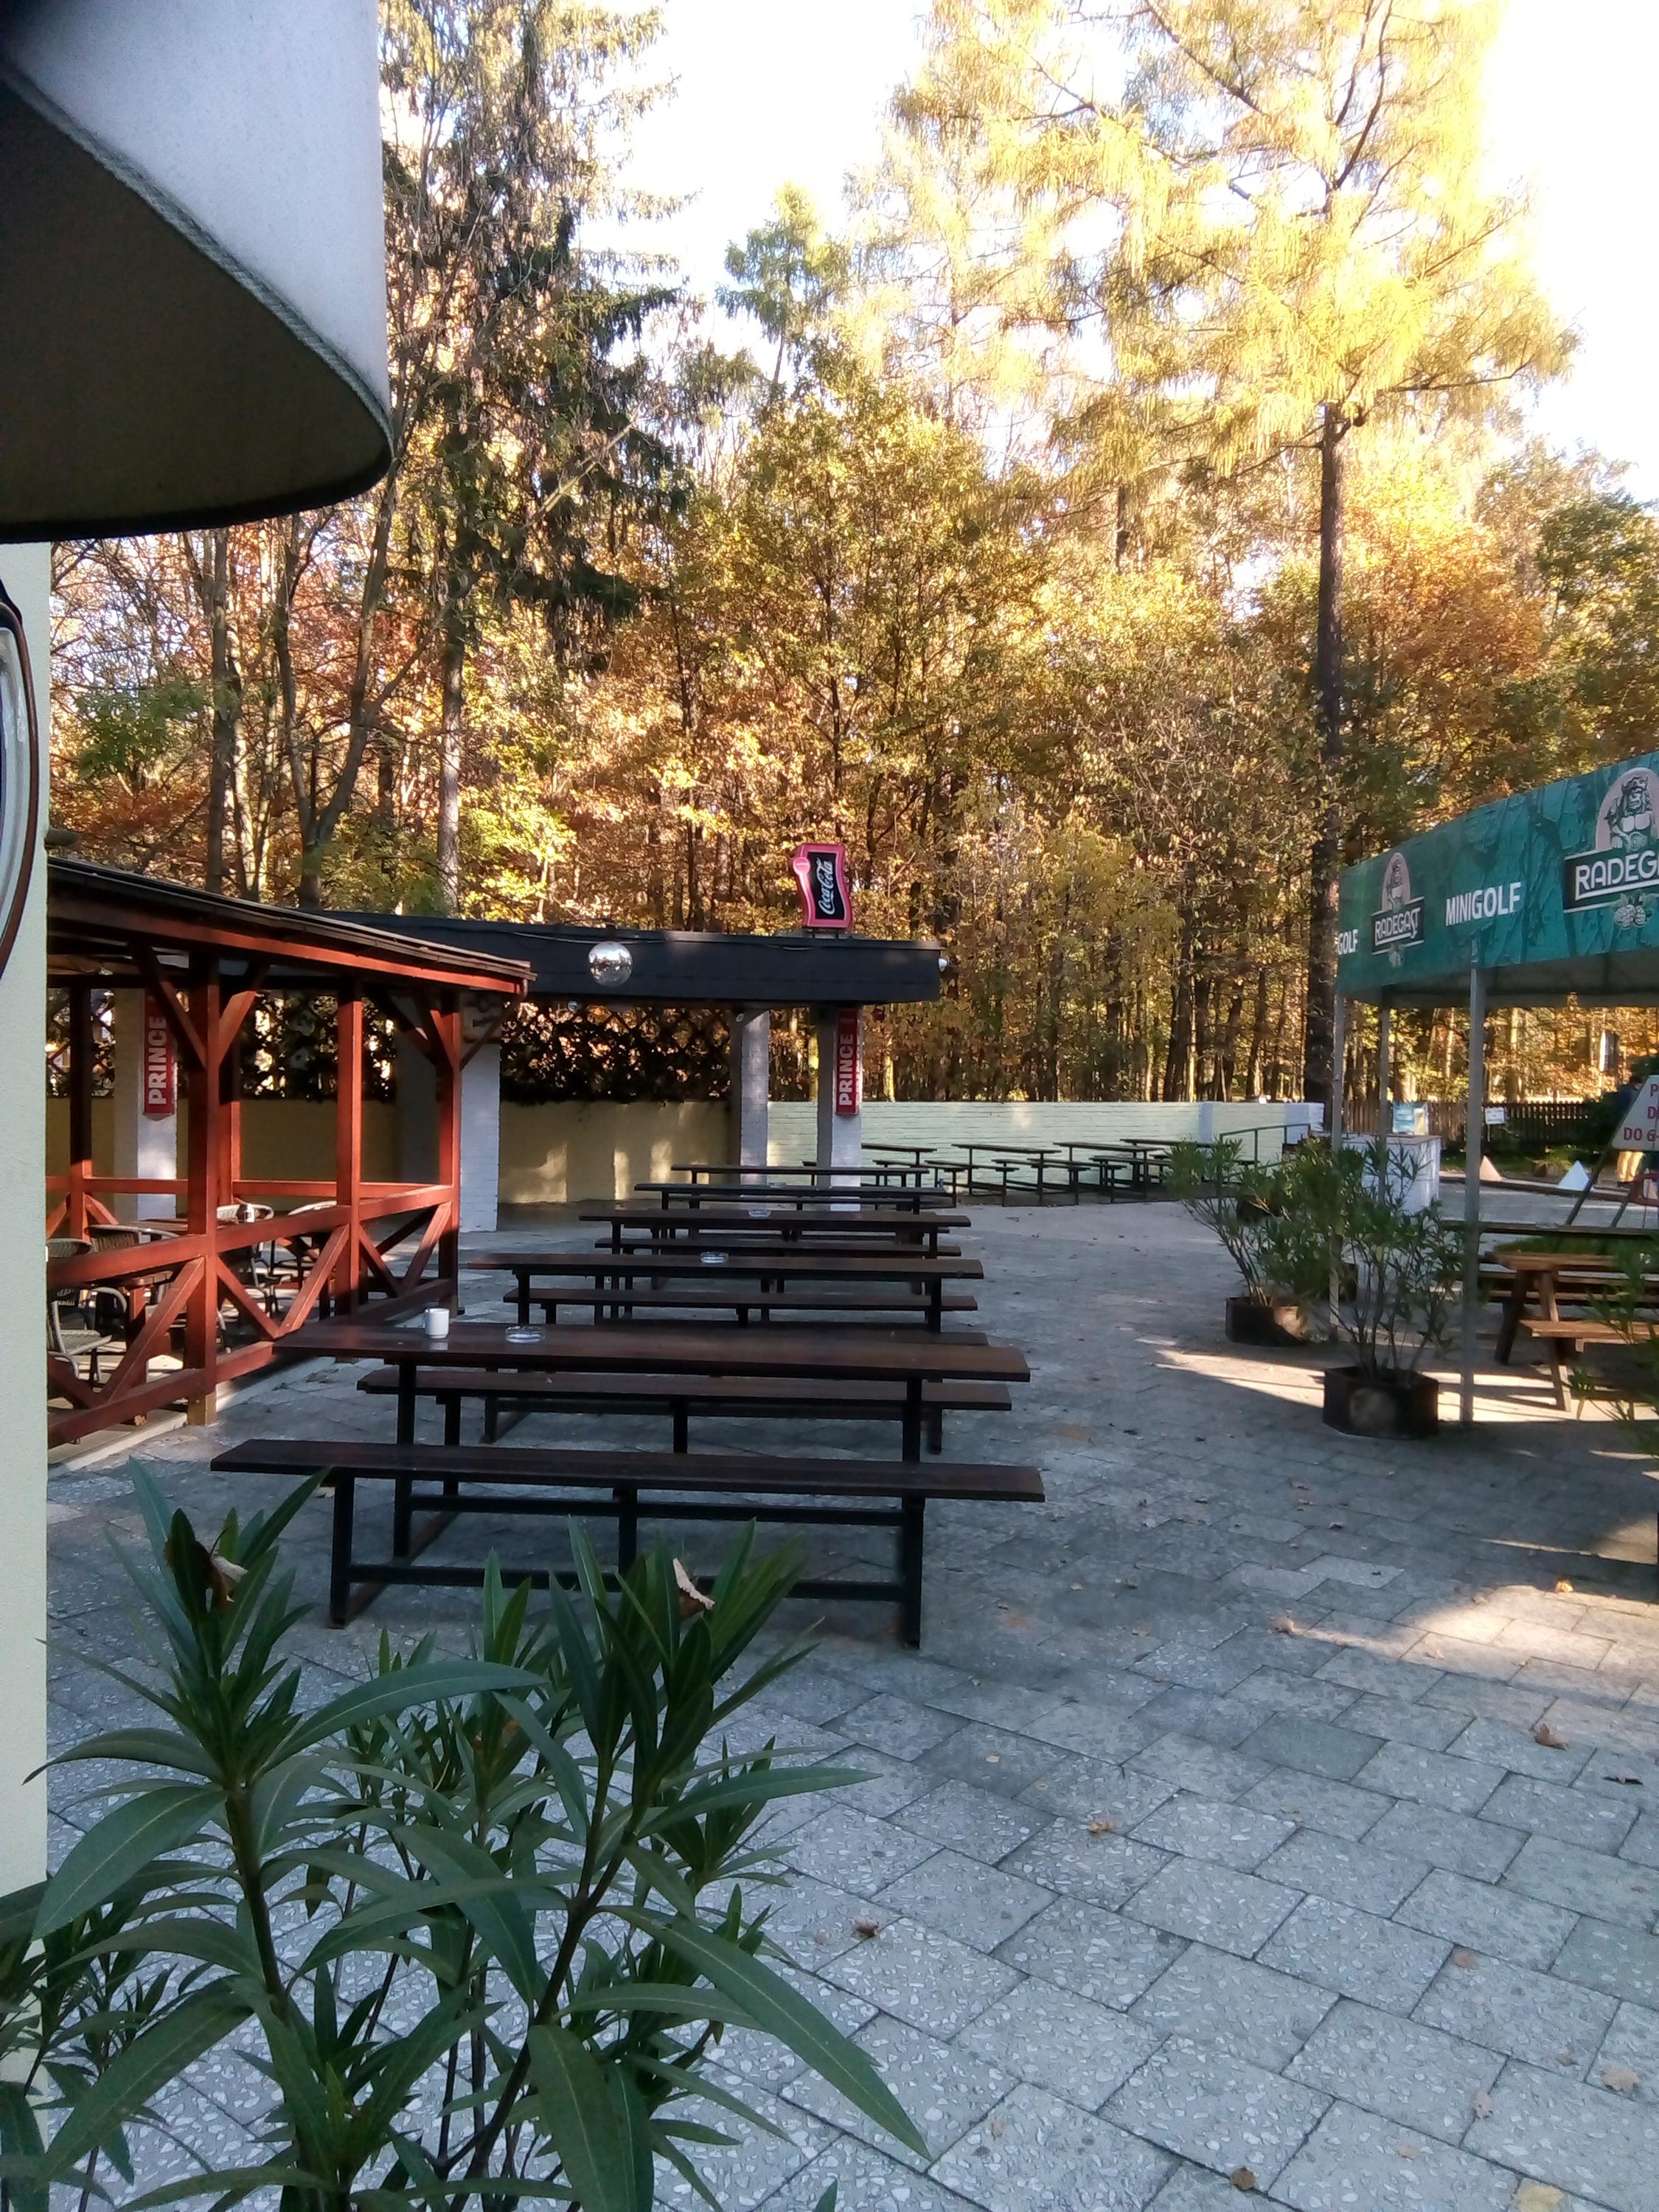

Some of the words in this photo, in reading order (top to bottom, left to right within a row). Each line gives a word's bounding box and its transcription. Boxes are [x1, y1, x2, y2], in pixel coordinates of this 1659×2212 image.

[1575, 849, 1659, 901] RADEG
[1374, 907, 1421, 946] RADEGAST
[1445, 881, 1522, 927] MINIGOLF
[147, 1015, 167, 1105] PRINCE
[838, 1034, 854, 1106] PRINCE
[1624, 1127, 1643, 1141] DO
